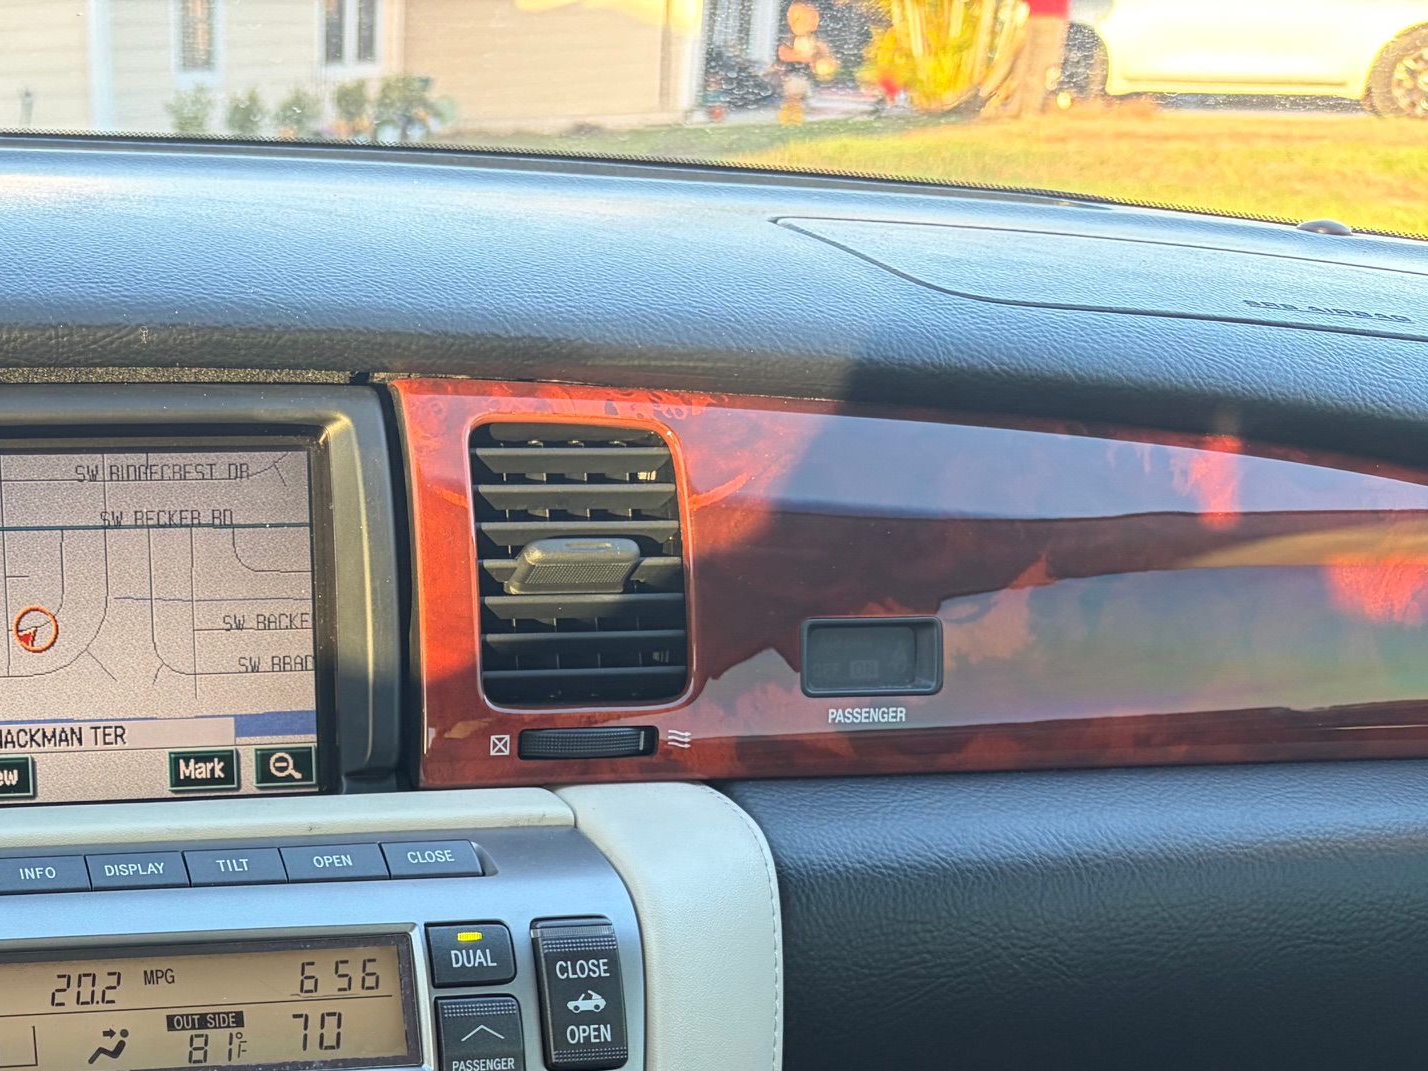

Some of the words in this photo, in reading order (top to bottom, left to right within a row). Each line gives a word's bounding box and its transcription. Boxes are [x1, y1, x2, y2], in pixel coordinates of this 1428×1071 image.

[75, 466, 99, 482] SW
[109, 463, 214, 481] RIDGECREST
[228, 463, 250, 480] DR
[100, 511, 123, 527] SW
[134, 509, 202, 527] BECKER
[212, 509, 234, 526] RD
[222, 613, 246, 631] SW
[238, 656, 261, 673] SW
[828, 707, 907, 723] PASSENGER
[90, 725, 127, 746] TER
[178, 757, 226, 780] Mark
[216, 858, 249, 873] TILT
[313, 854, 353, 868] OPEN
[407, 849, 455, 864] CLOSE
[19, 866, 56, 880] INFO
[104, 862, 165, 877] DISPLAY
[450, 949, 498, 968] DUAL
[555, 959, 610, 980] CLOSE
[50, 971, 122, 1008] 20.2
[143, 968, 176, 986] MPG
[173, 1014, 201, 1030] OUT
[206, 1013, 237, 1028] SIDE
[292, 1011, 343, 1052] 70
[566, 1024, 613, 1044] OPEN
